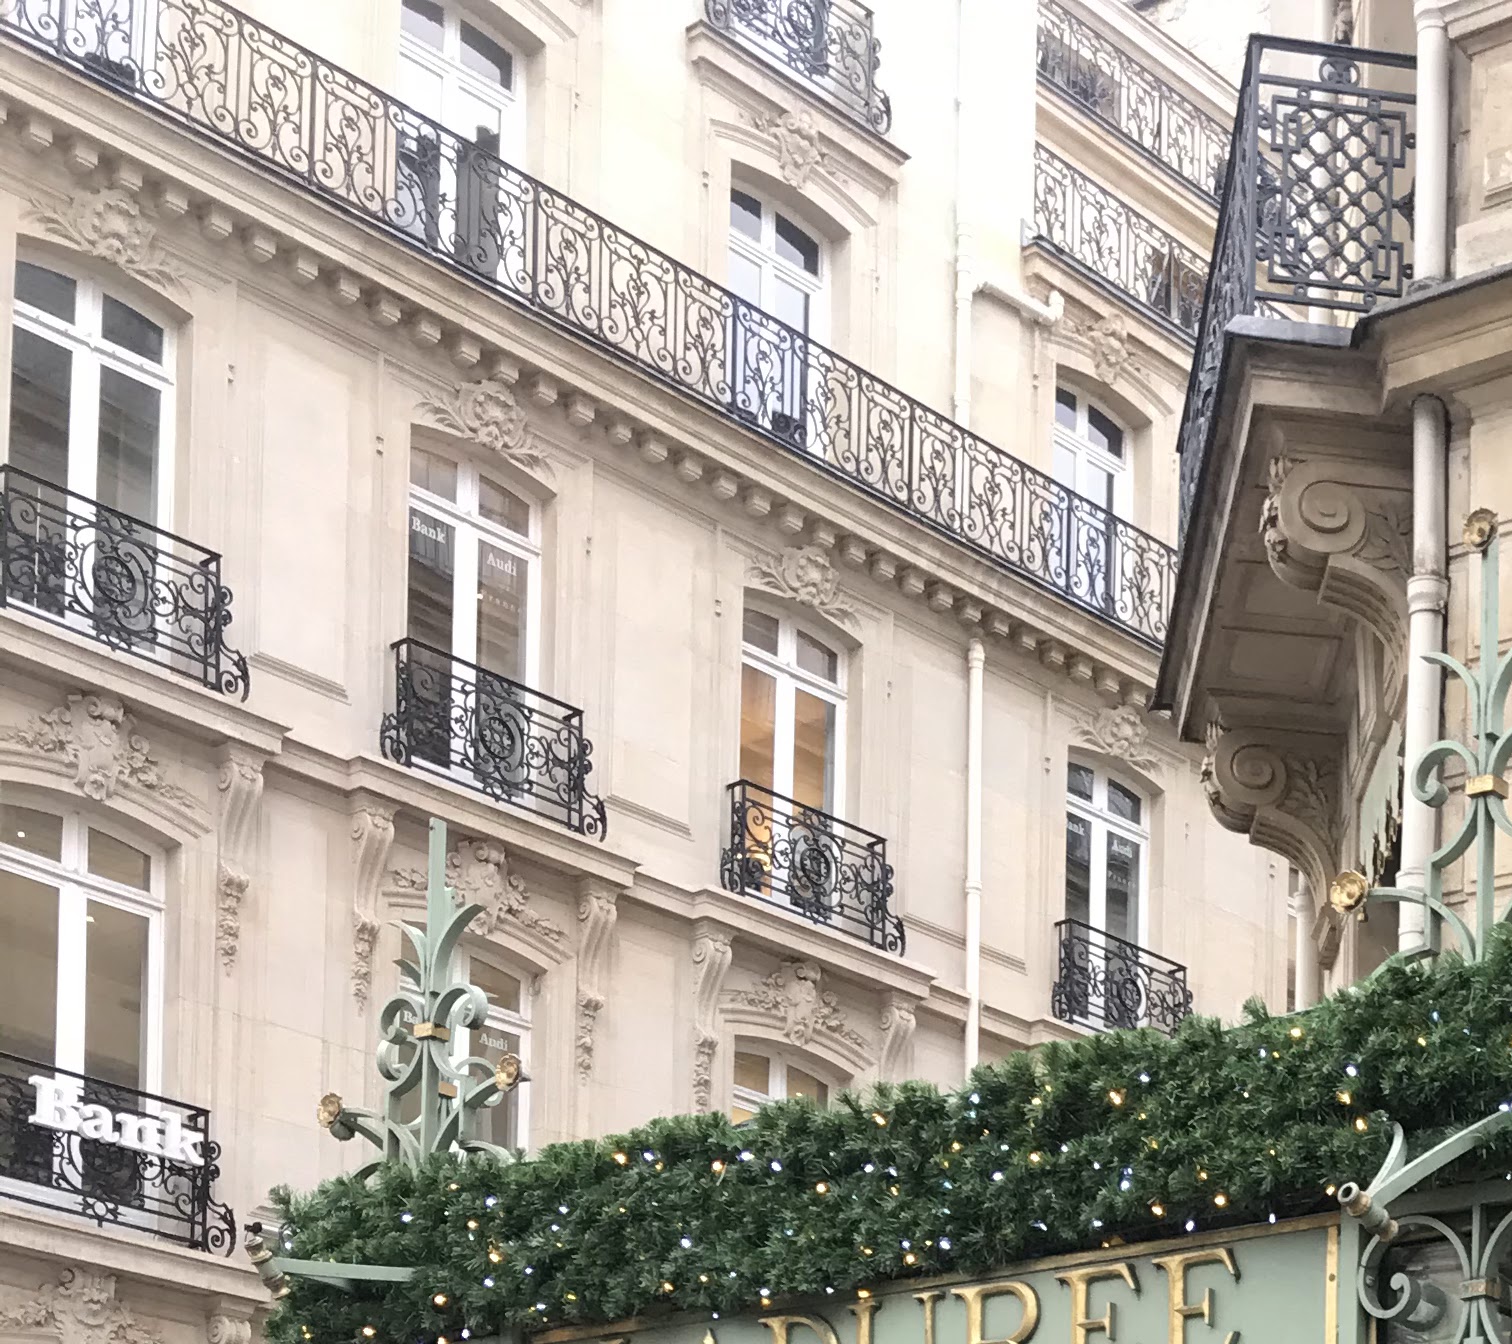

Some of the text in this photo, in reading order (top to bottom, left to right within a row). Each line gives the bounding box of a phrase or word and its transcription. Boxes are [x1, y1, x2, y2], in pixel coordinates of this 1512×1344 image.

[411, 516, 446, 544] Bank
[486, 552, 517, 576] Audi
[479, 1033, 508, 1051] Audi
[28, 1074, 205, 1167] Bank
